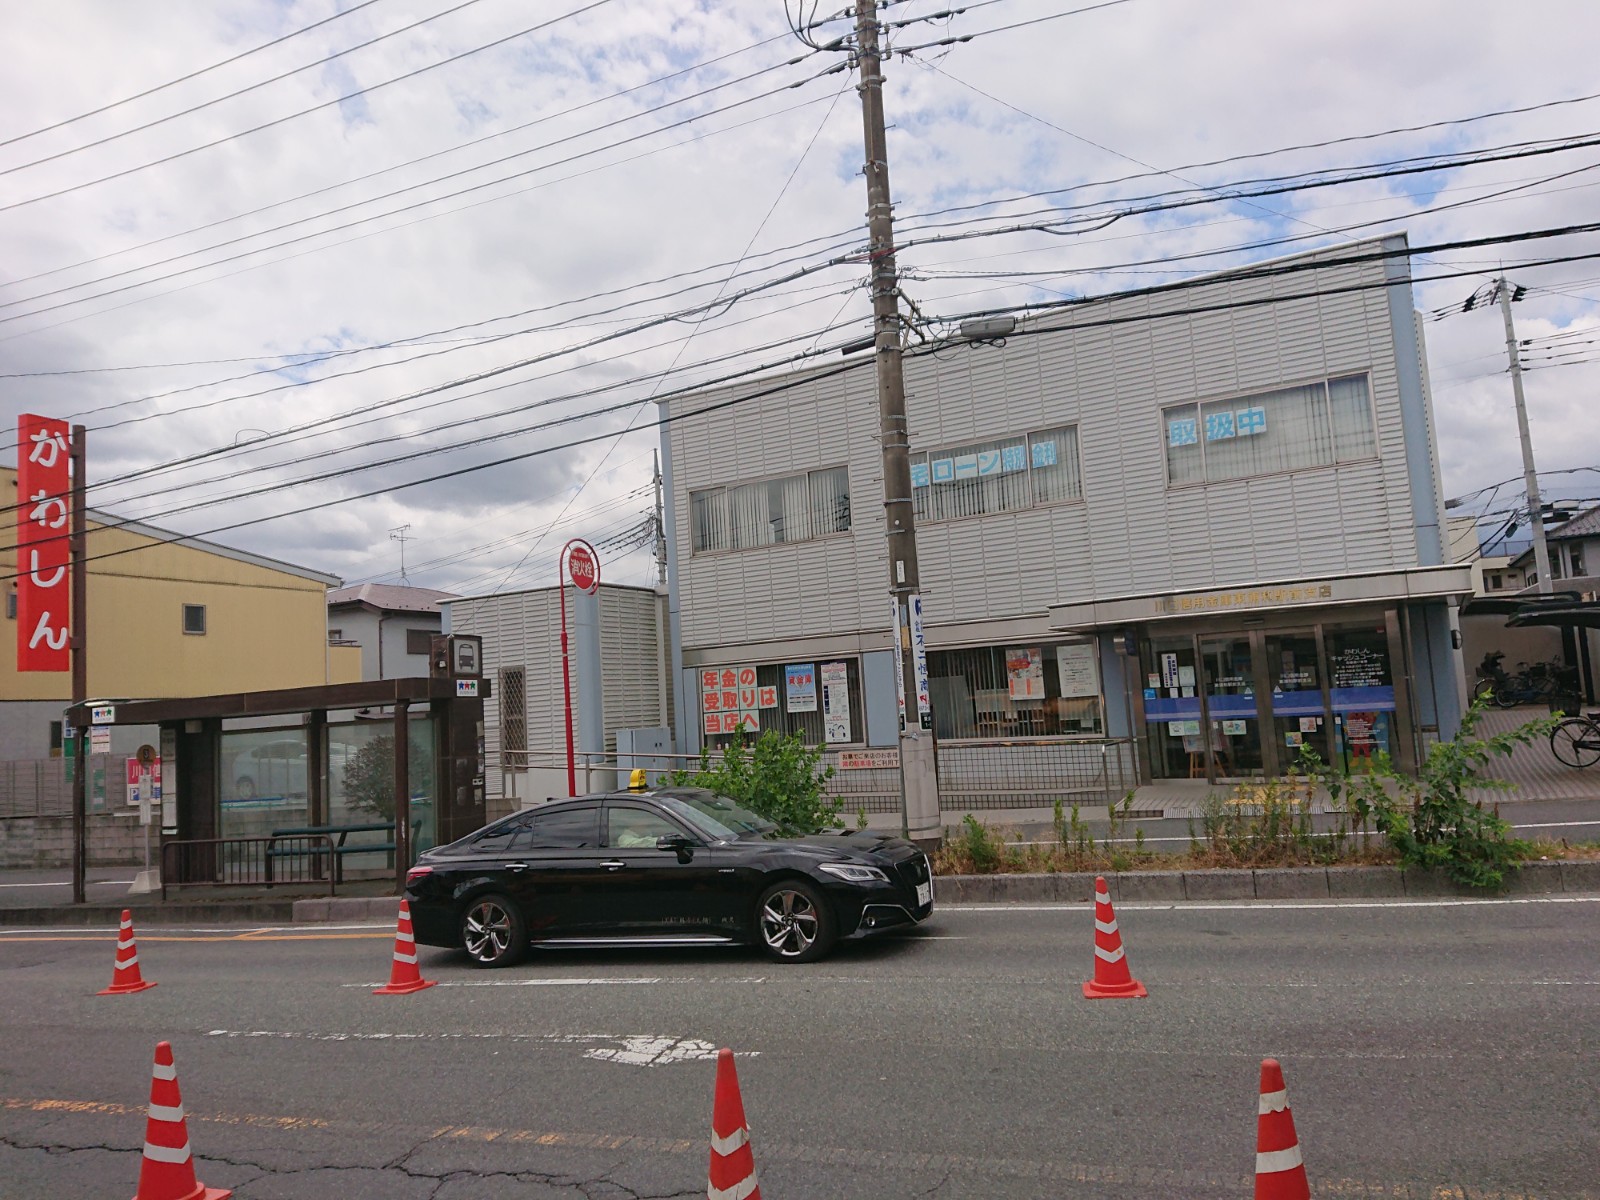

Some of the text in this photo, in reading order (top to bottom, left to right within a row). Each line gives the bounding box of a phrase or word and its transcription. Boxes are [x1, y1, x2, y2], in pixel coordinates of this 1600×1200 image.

[1169, 407, 1266, 445] 取扱中
[29, 428, 67, 650] かわしん
[703, 668, 756, 690] 年金の
[704, 687, 776, 711] 受取りは
[706, 712, 759, 733] 当店へ
